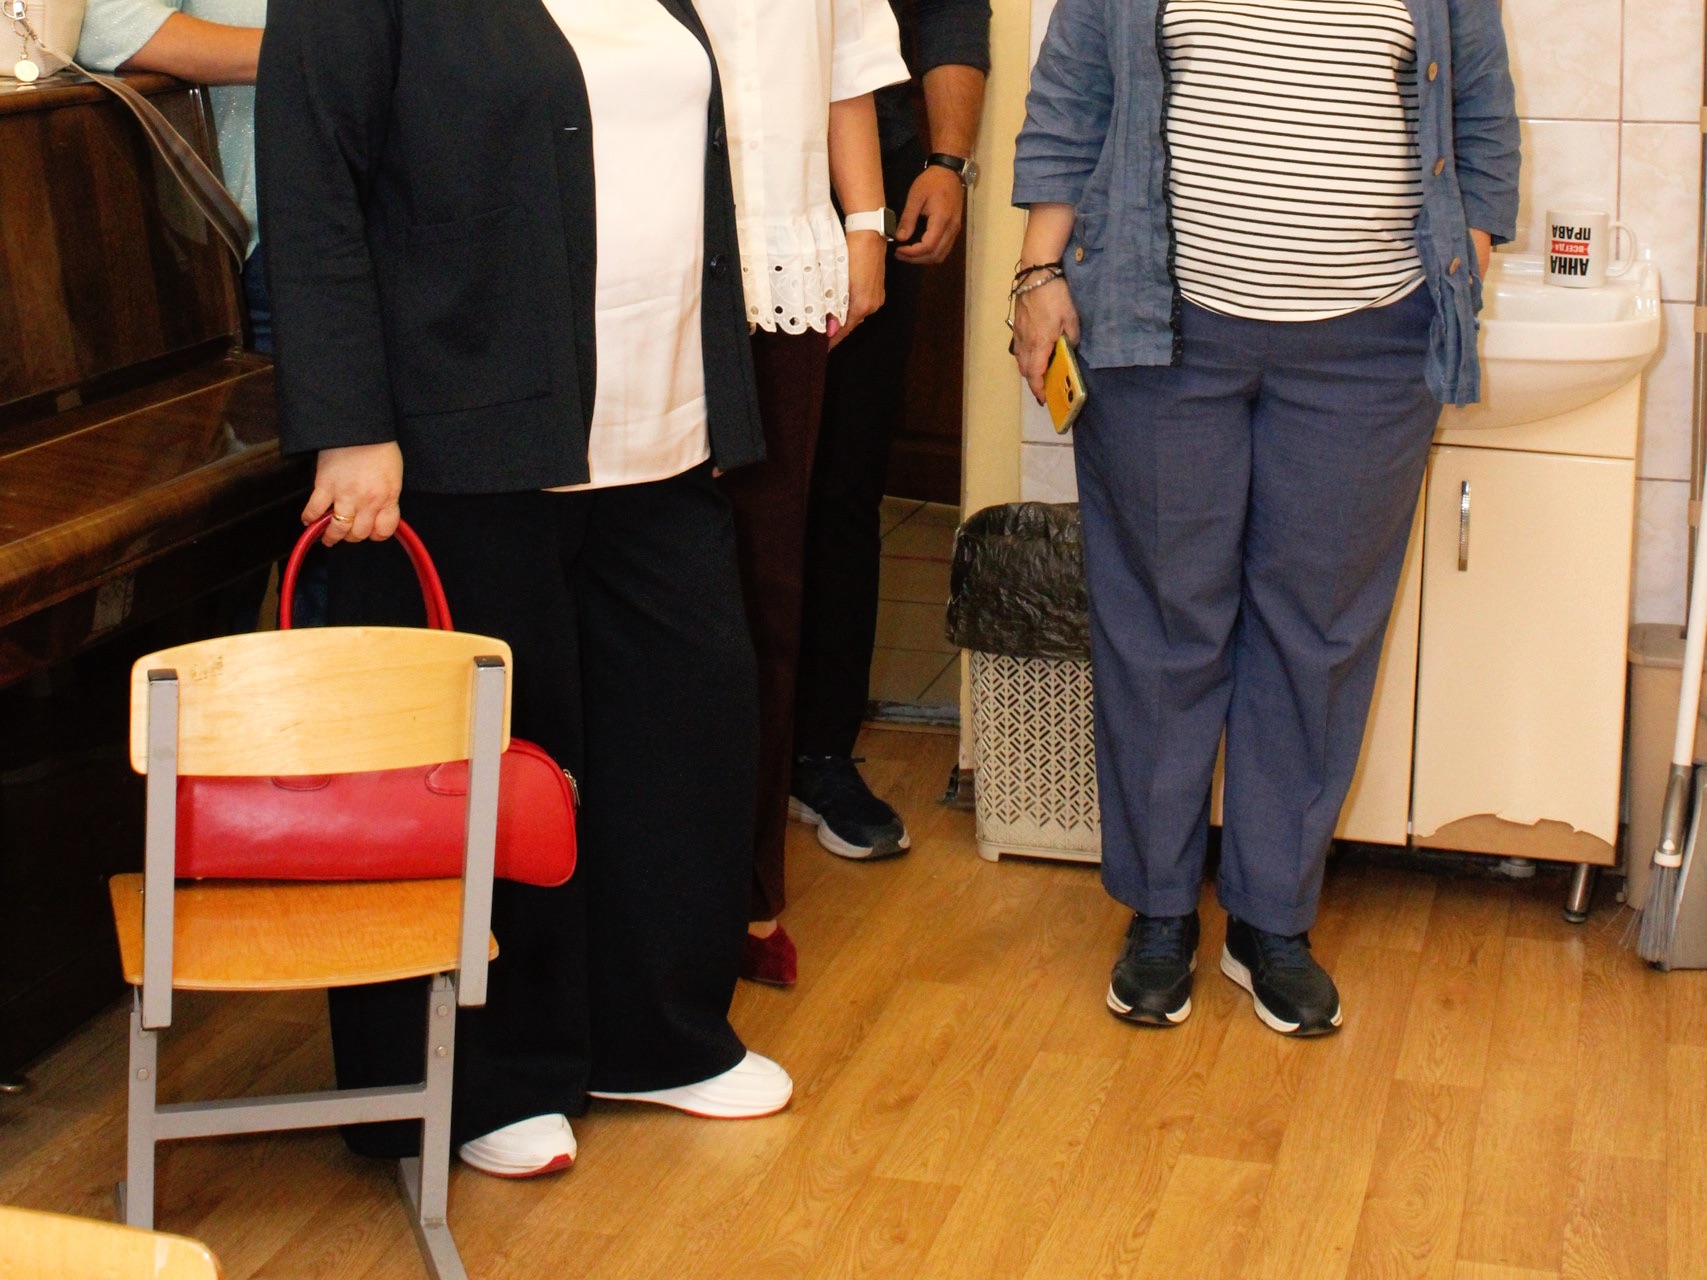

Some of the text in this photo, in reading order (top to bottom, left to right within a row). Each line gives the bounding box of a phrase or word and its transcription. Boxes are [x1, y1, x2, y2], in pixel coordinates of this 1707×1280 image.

[1551, 224, 1591, 241] ПРАВА
[1555, 243, 1585, 253] ВСЕГДА
[1550, 255, 1590, 276] АННА
